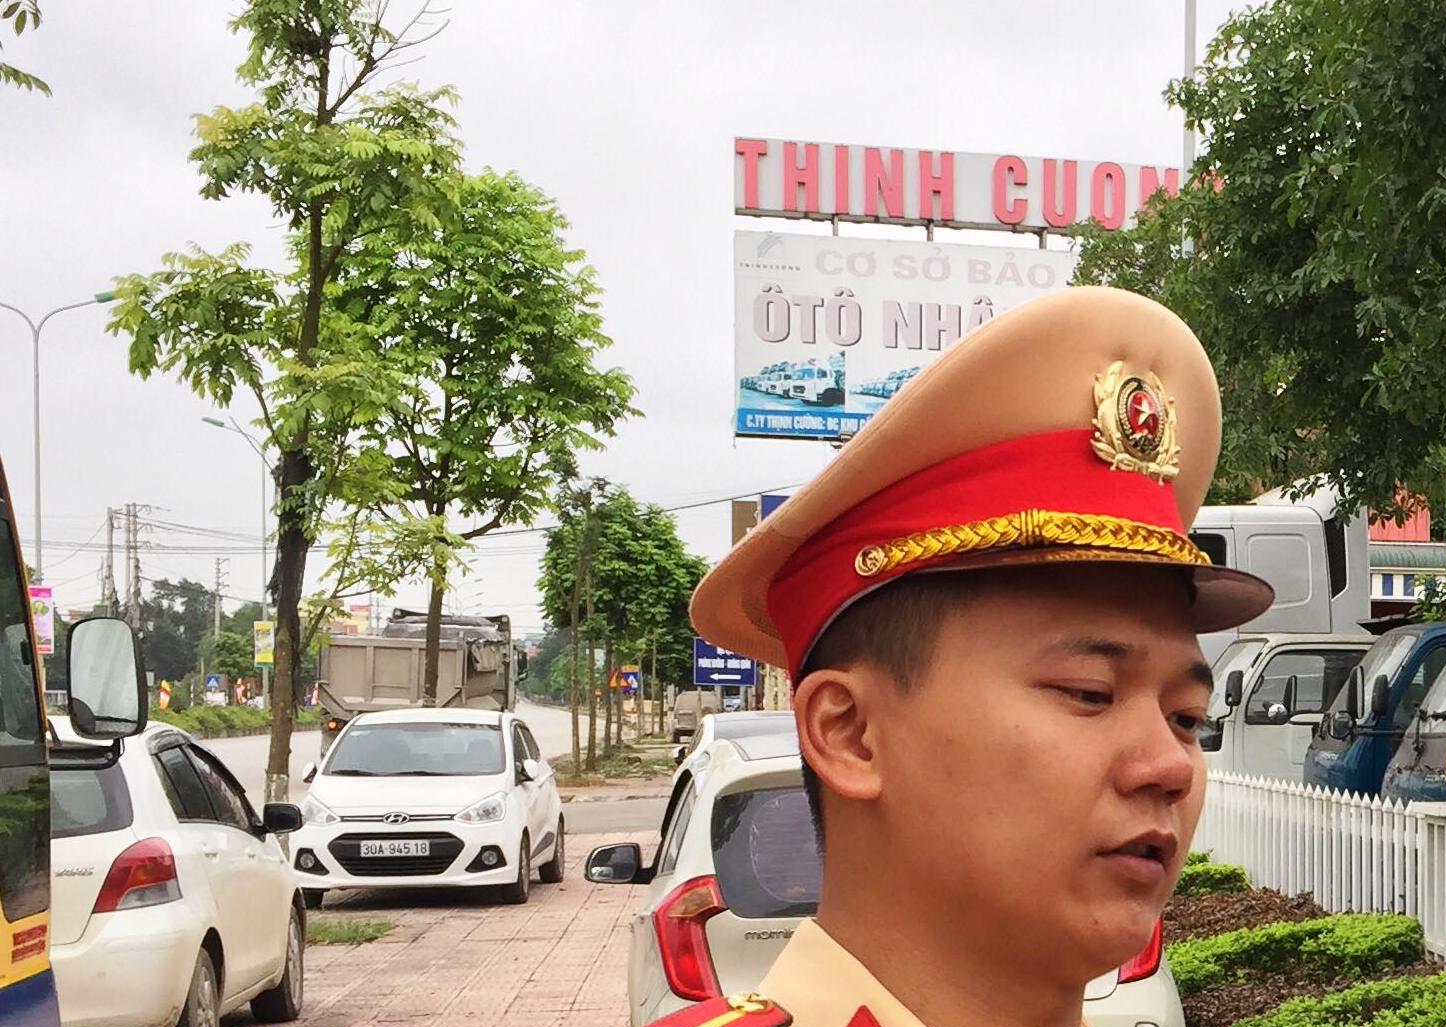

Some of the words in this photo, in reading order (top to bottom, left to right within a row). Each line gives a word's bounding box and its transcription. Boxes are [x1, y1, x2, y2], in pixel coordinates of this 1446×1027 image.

[735, 137, 955, 222] THINH
[992, 155, 1224, 231] CUON
[816, 249, 877, 278] CƠ
[893, 247, 951, 282] SỞ
[967, 252, 1057, 290] BẢO
[753, 283, 862, 347] ÔTÔ
[882, 295, 994, 351] NHÂ
